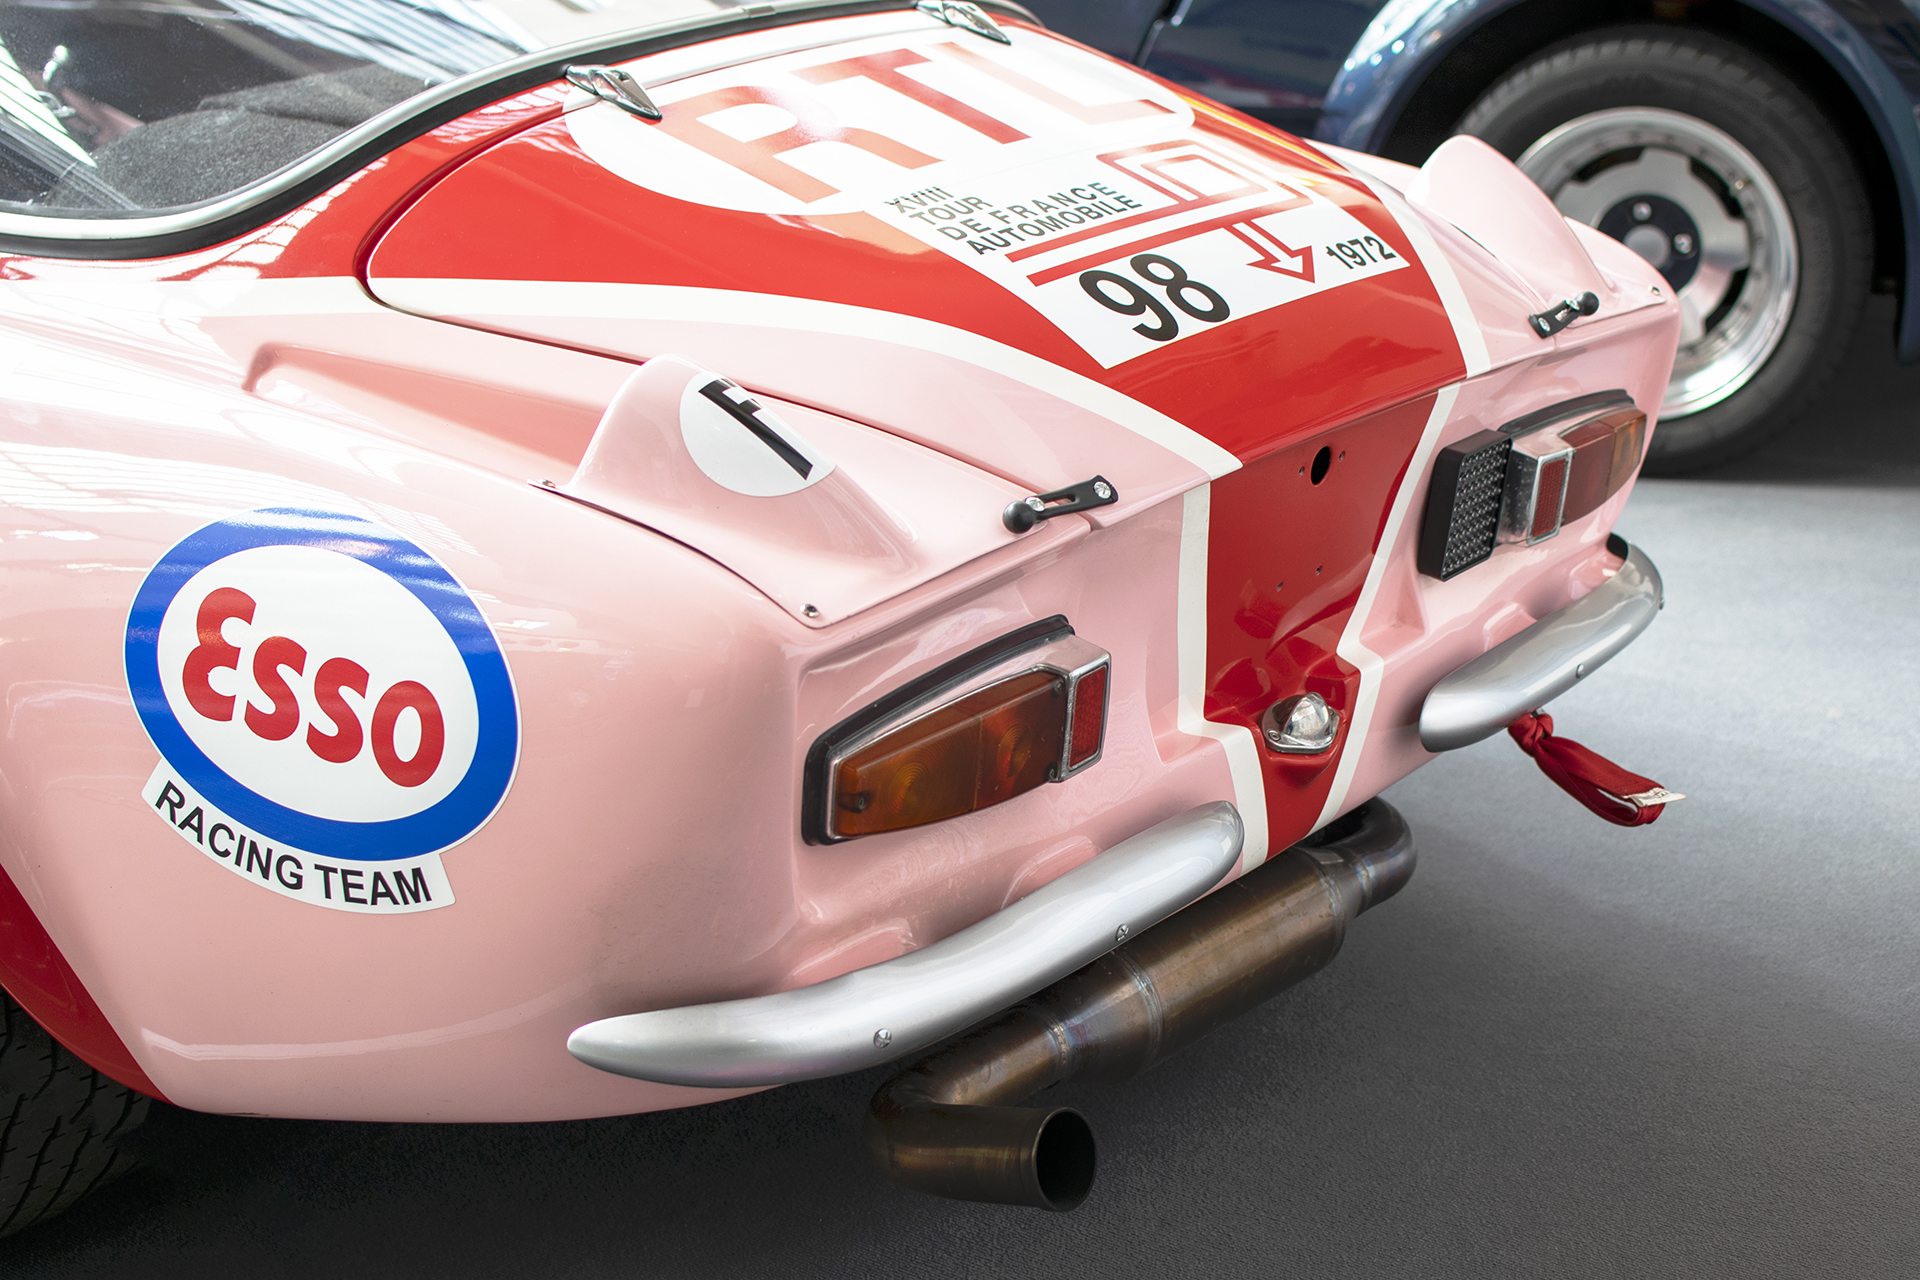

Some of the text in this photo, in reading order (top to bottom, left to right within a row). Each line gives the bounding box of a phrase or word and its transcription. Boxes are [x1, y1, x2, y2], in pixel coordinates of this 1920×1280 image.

[631, 42, 1177, 204] RTL
[884, 186, 954, 214] XVIII
[908, 196, 993, 226] TOUR
[936, 182, 1117, 241] DE FRANCE
[966, 195, 1144, 256] AUTOMOBILE
[1326, 235, 1397, 270] 1972
[1079, 253, 1231, 342] 98
[698, 378, 813, 481] F
[182, 586, 446, 788] ESSO
[155, 779, 433, 907] RACING TEAM
